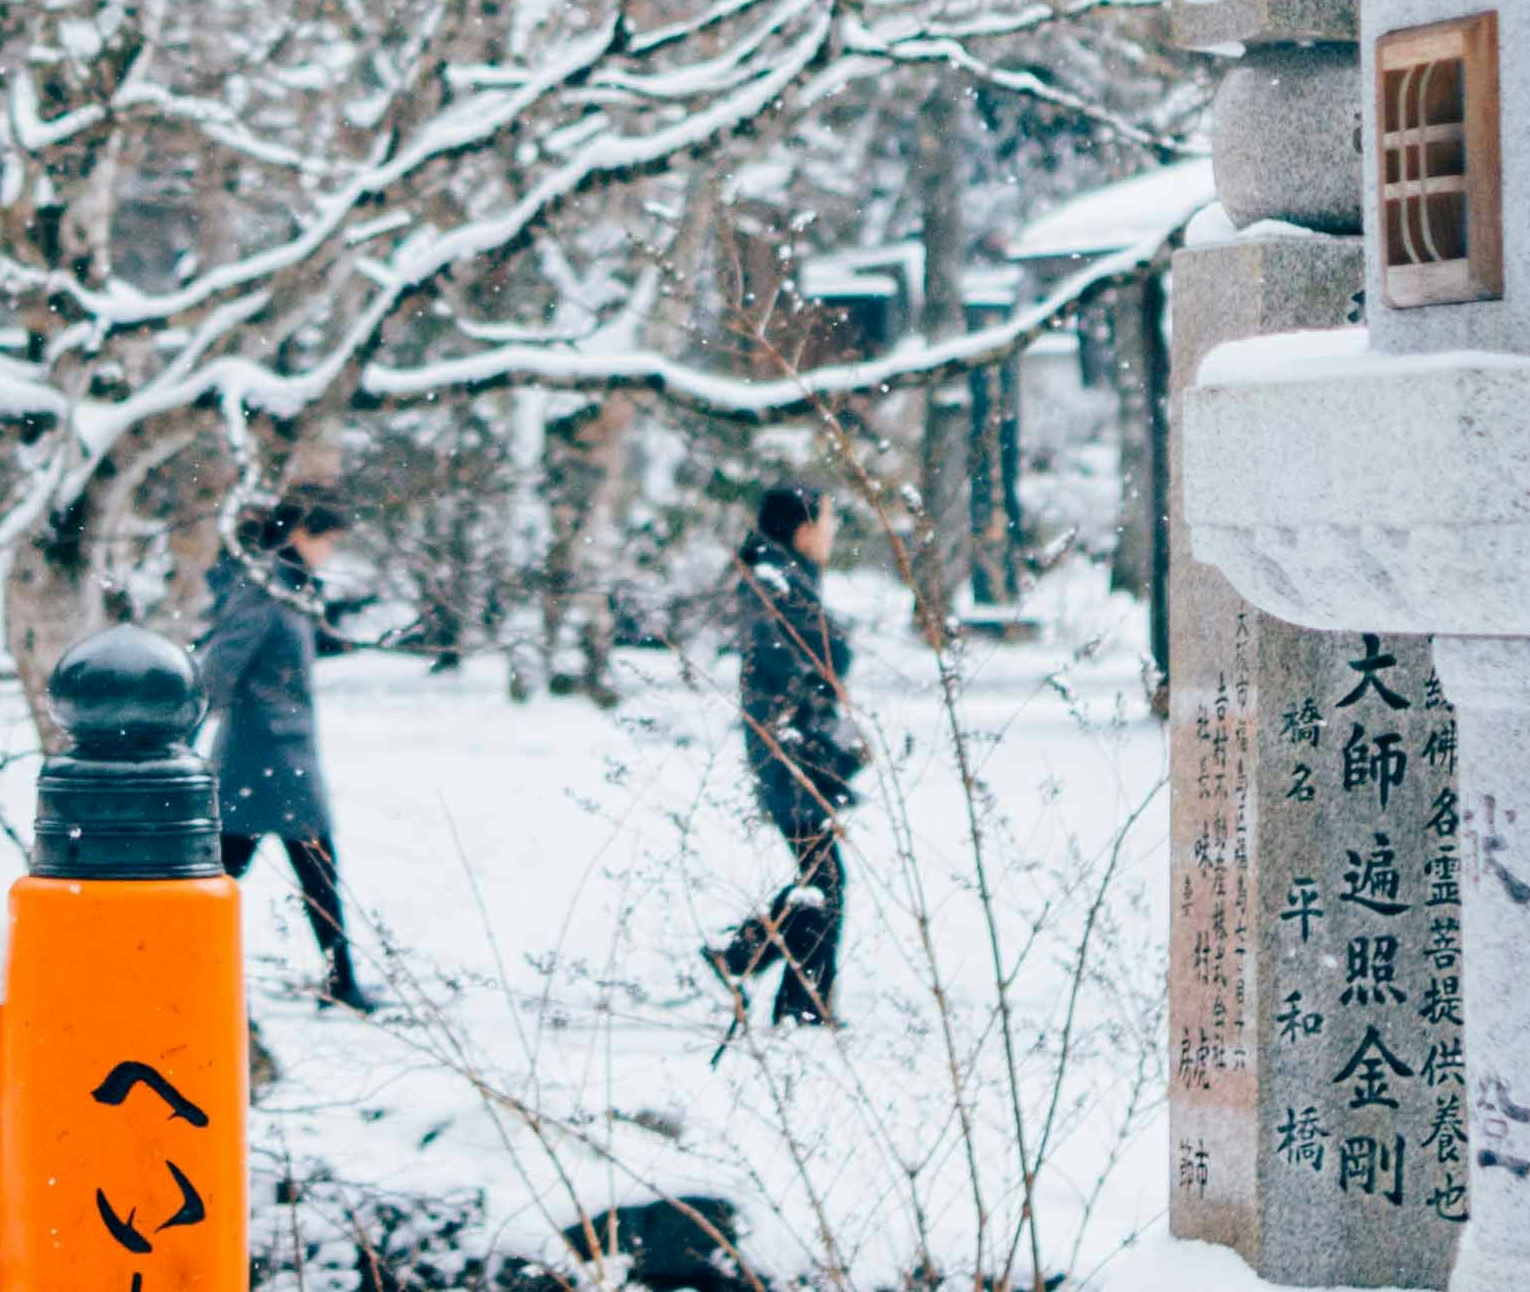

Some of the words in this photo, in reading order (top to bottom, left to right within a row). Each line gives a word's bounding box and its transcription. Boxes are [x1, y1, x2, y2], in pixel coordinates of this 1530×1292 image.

[1333, 633, 1415, 1206] 大師遍照金剛
